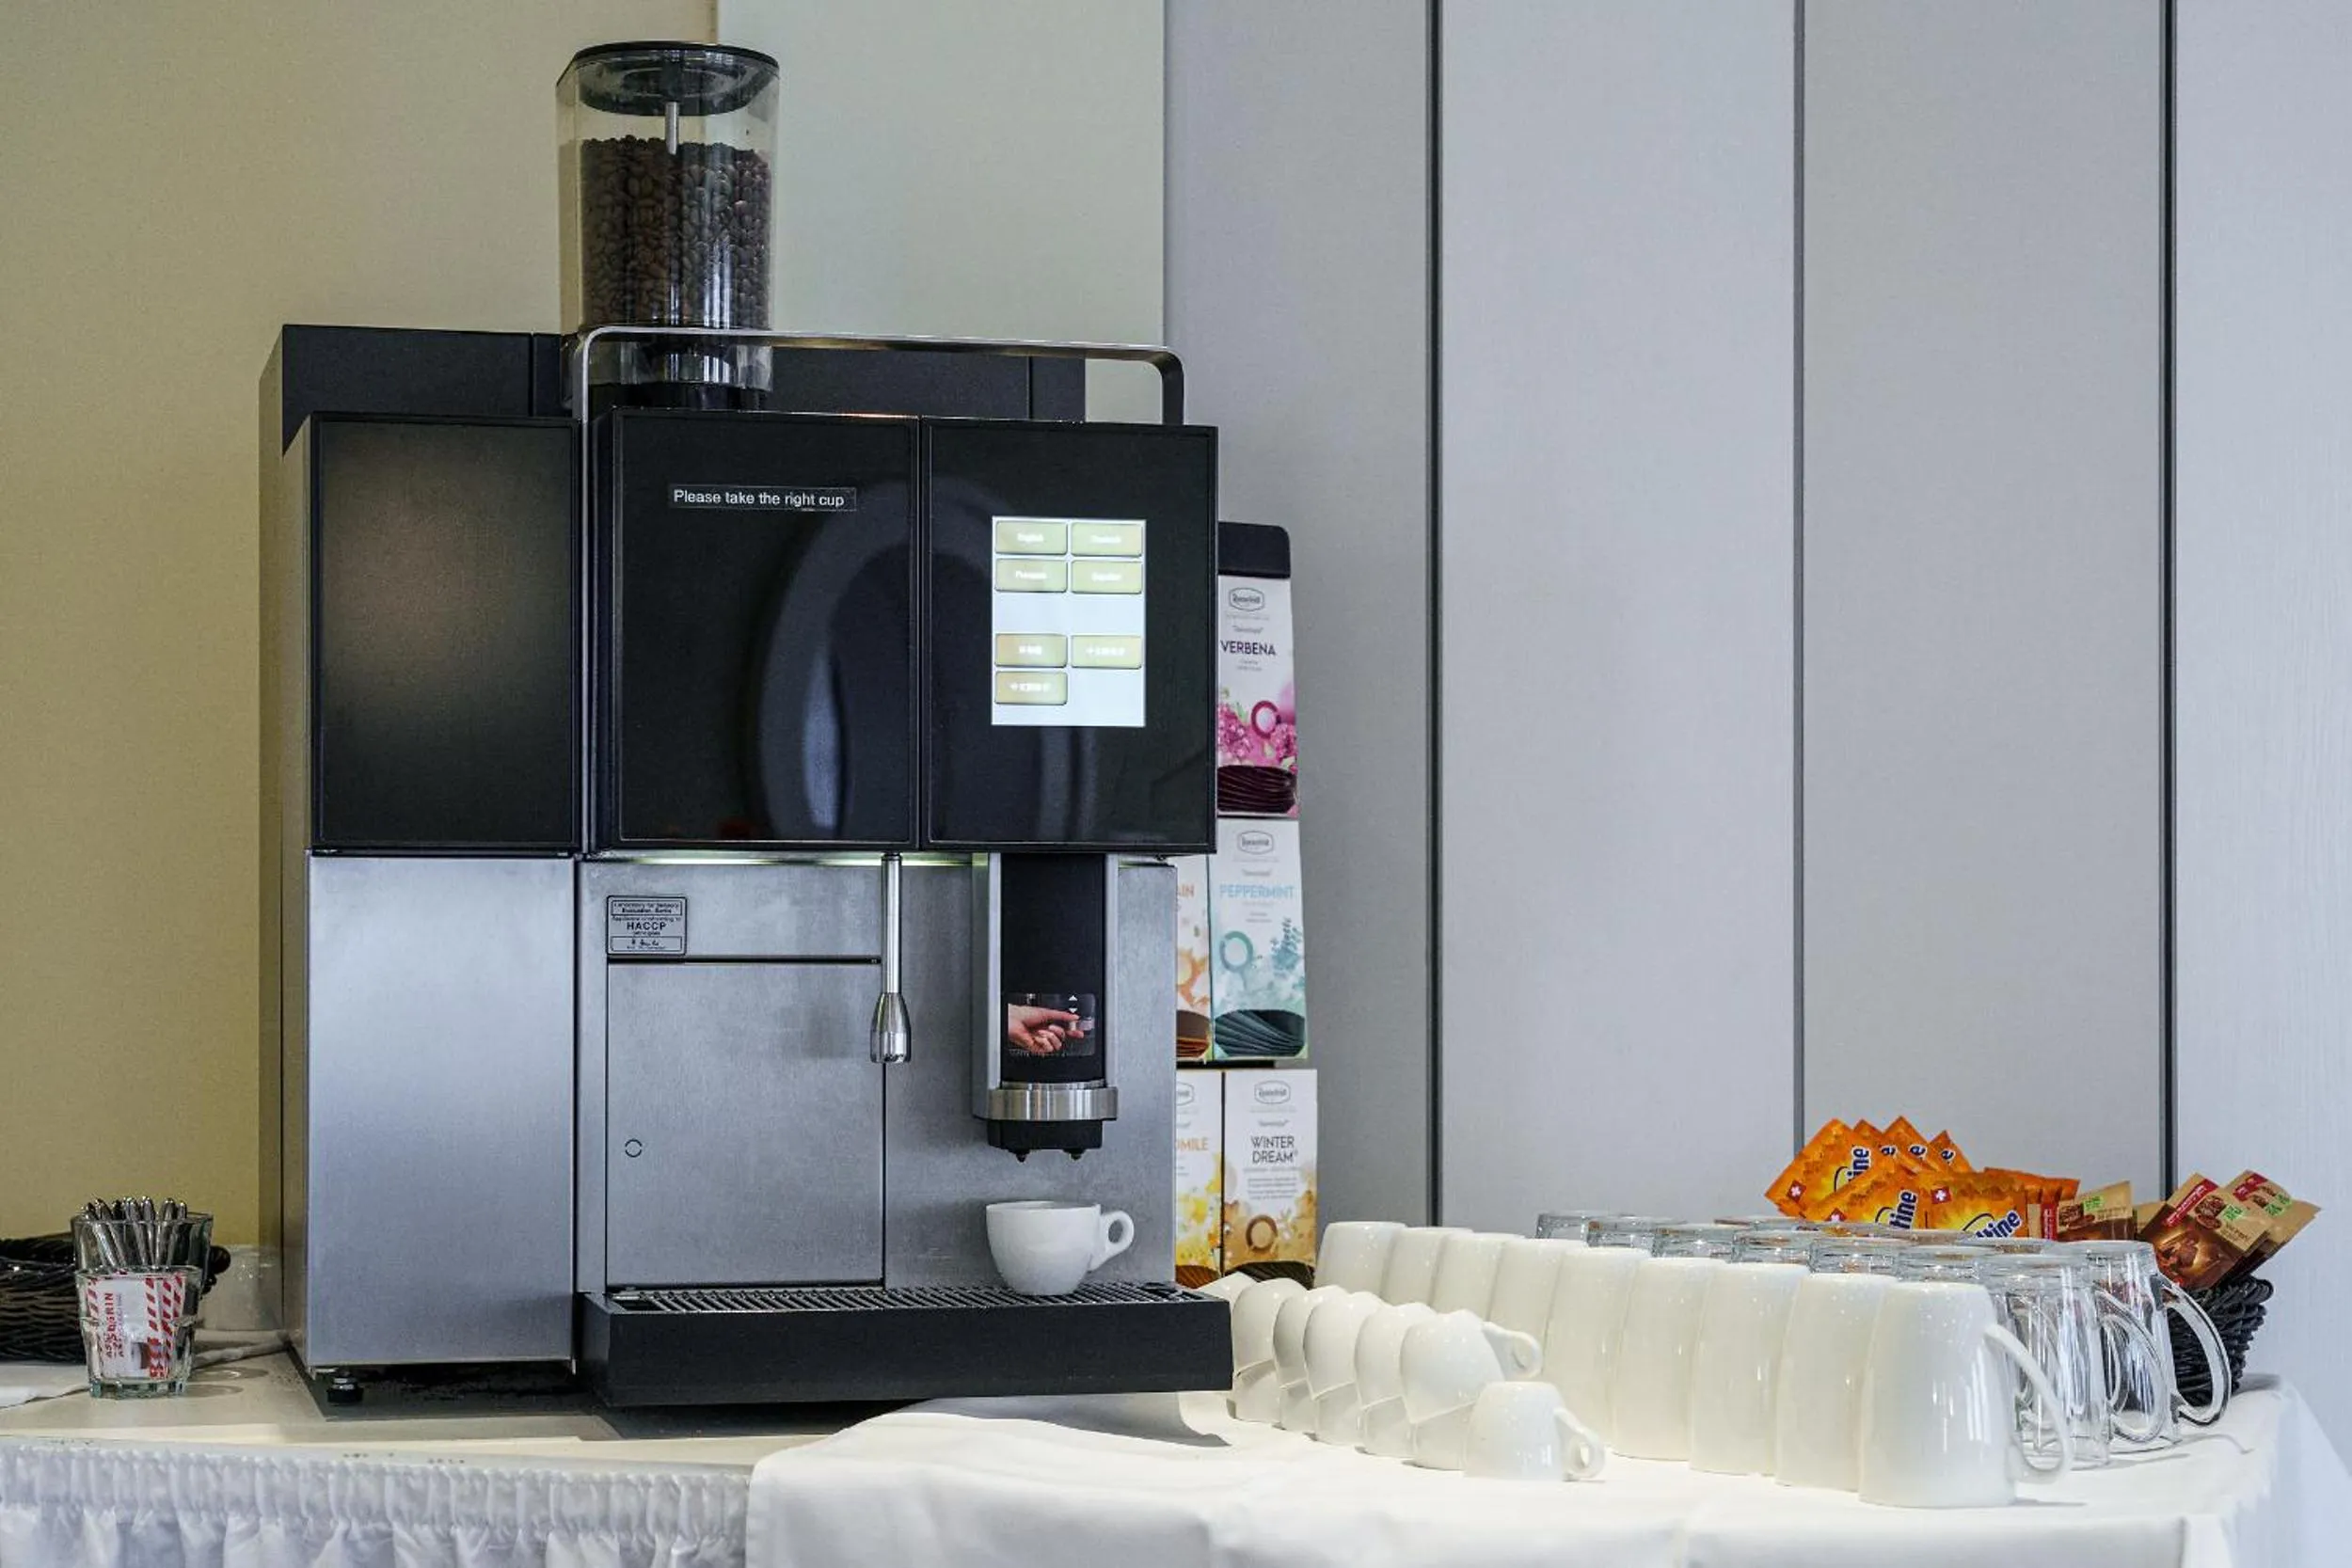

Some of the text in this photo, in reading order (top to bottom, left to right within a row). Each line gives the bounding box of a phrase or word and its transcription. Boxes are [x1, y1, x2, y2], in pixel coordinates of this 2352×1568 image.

[674, 489, 845, 508] Please take the right cup
[1220, 641, 1277, 656] VERBENA
[1219, 884, 1295, 898] PEPPERMINT
[627, 922, 667, 930] HACCP
[1250, 1135, 1295, 1150] WINTER
